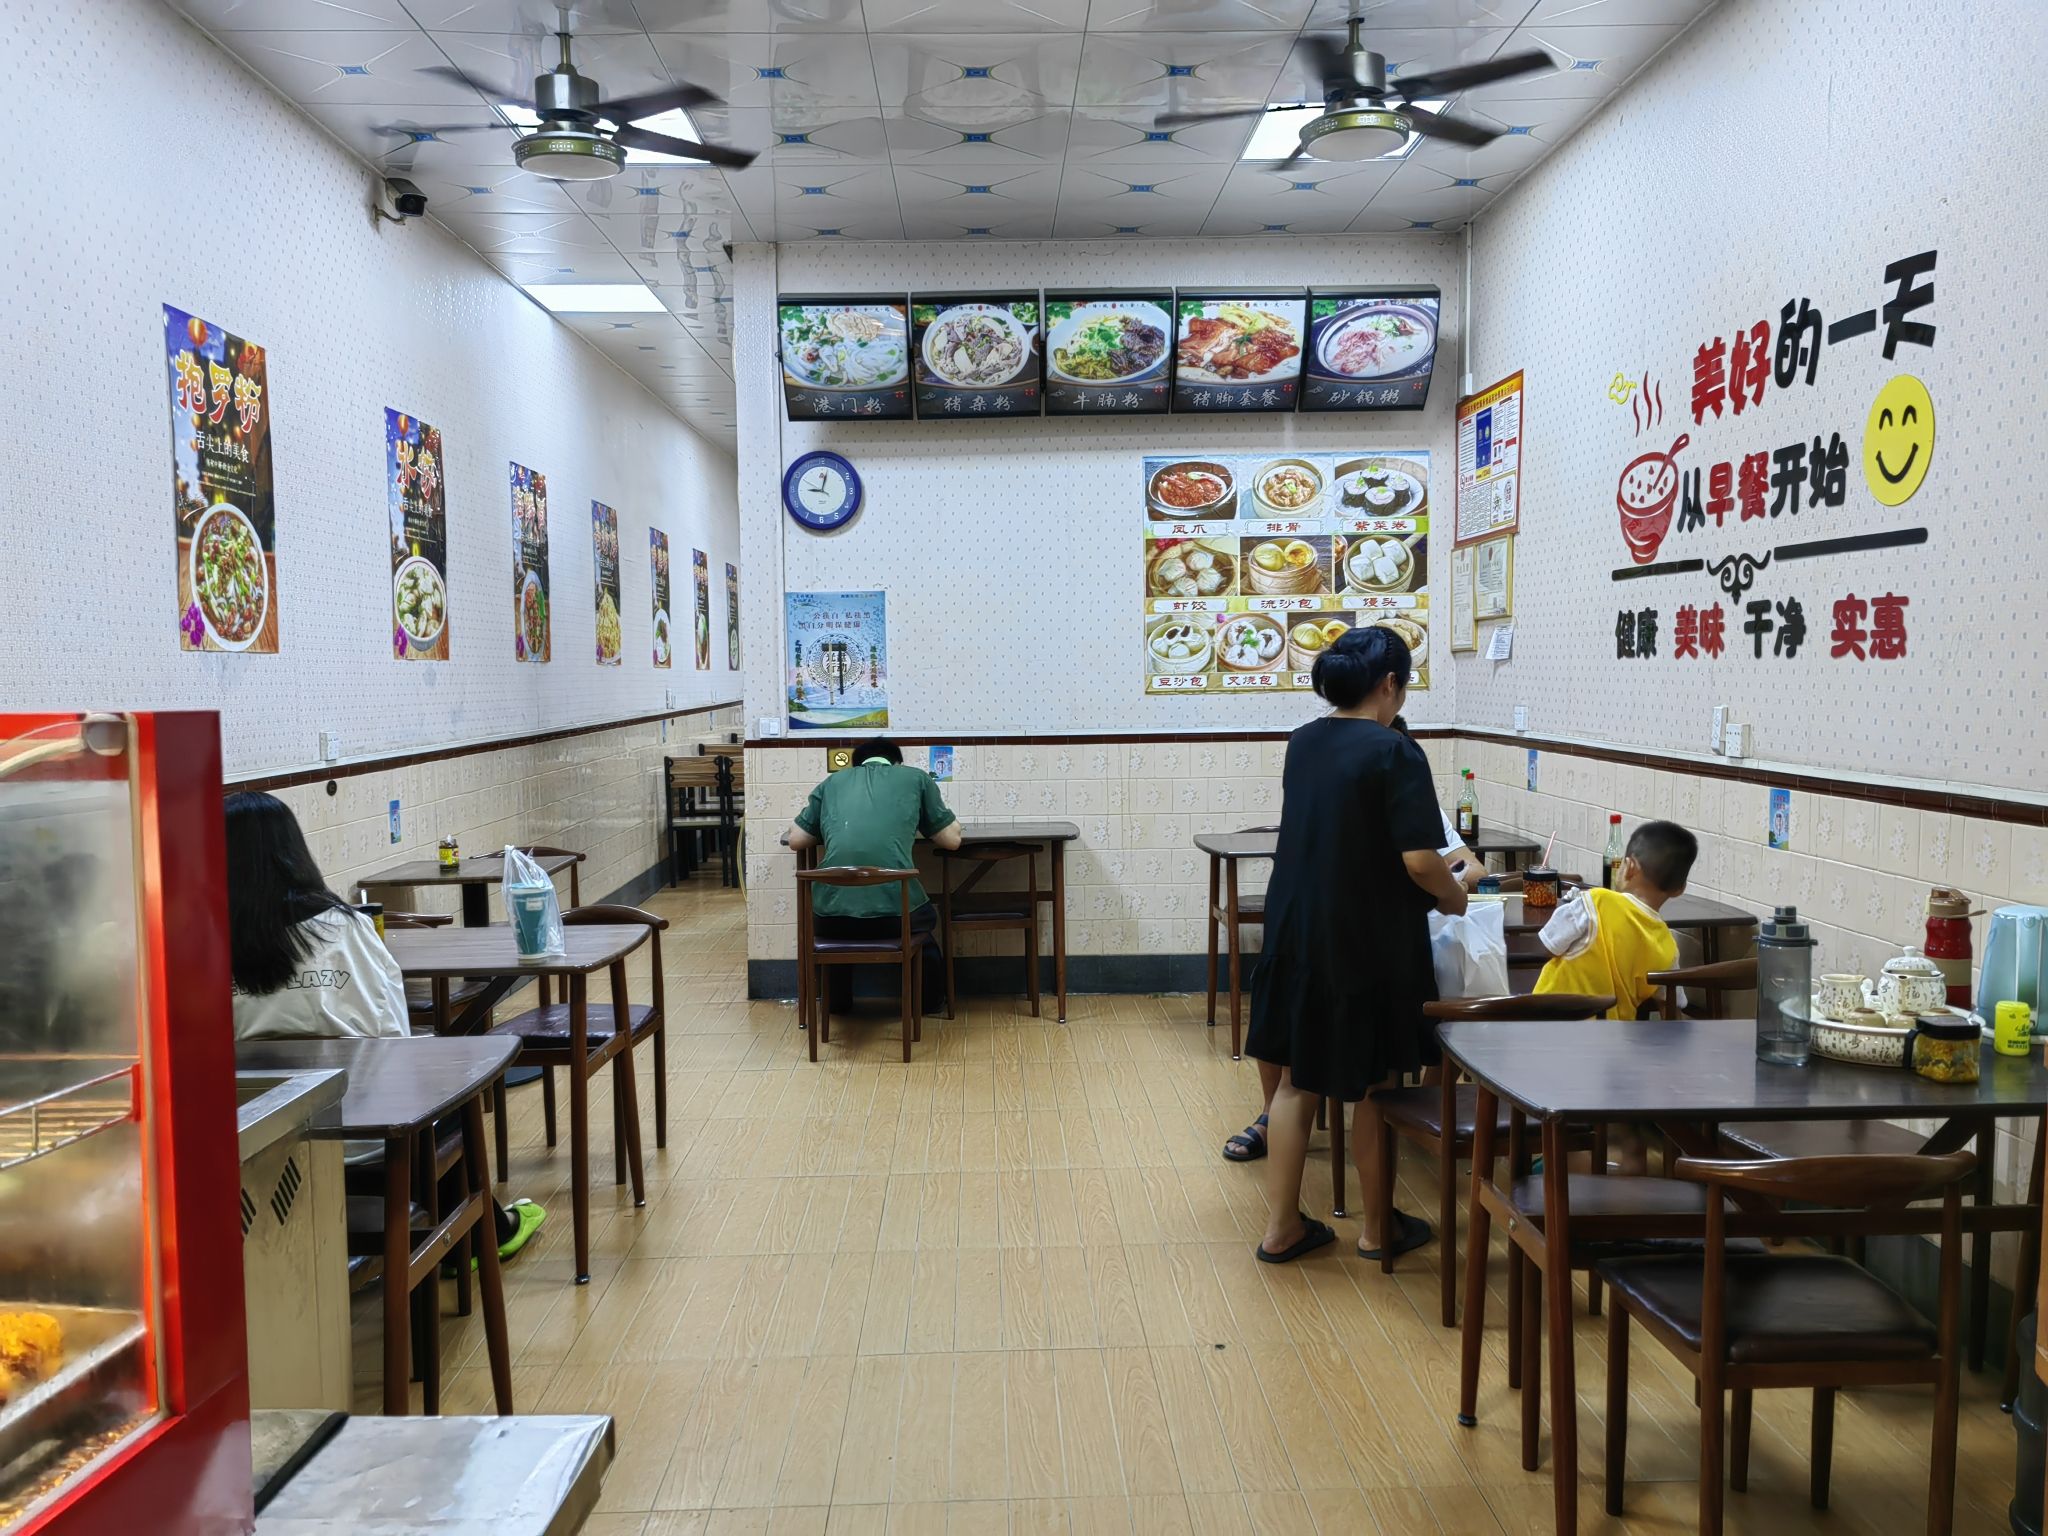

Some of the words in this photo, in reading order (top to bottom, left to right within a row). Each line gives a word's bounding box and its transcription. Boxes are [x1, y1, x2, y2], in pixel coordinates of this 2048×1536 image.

[1690, 250, 1938, 425] 美好的一天
[174, 349, 262, 434] 抱罗粉
[1073, 391, 1144, 410] 牛腩粉
[1192, 388, 1281, 408] 猪脚套餐
[1326, 388, 1401, 406] 砂锅粥
[812, 395, 888, 414] 港门粉
[943, 394, 1016, 413] 猪杂粉
[196, 430, 250, 464] 舌尖上的美食
[1677, 432, 1849, 533] 从早餐开始
[1171, 523, 1208, 535] 凤爪
[1266, 522, 1301, 533] 排骨
[1353, 519, 1409, 532] 紫菜卷
[1172, 600, 1208, 612] 虾饺
[1260, 597, 1313, 610] 流沙包
[1362, 596, 1398, 608] 馒头
[1615, 606, 1659, 660] 健康
[1673, 601, 1726, 660] 美味
[1744, 596, 1808, 660] 干净
[1829, 592, 1910, 661] 实惠
[1158, 675, 1204, 687] 豆沙包
[1226, 675, 1272, 687] 叉烧包
[286, 969, 351, 990] LAZY
